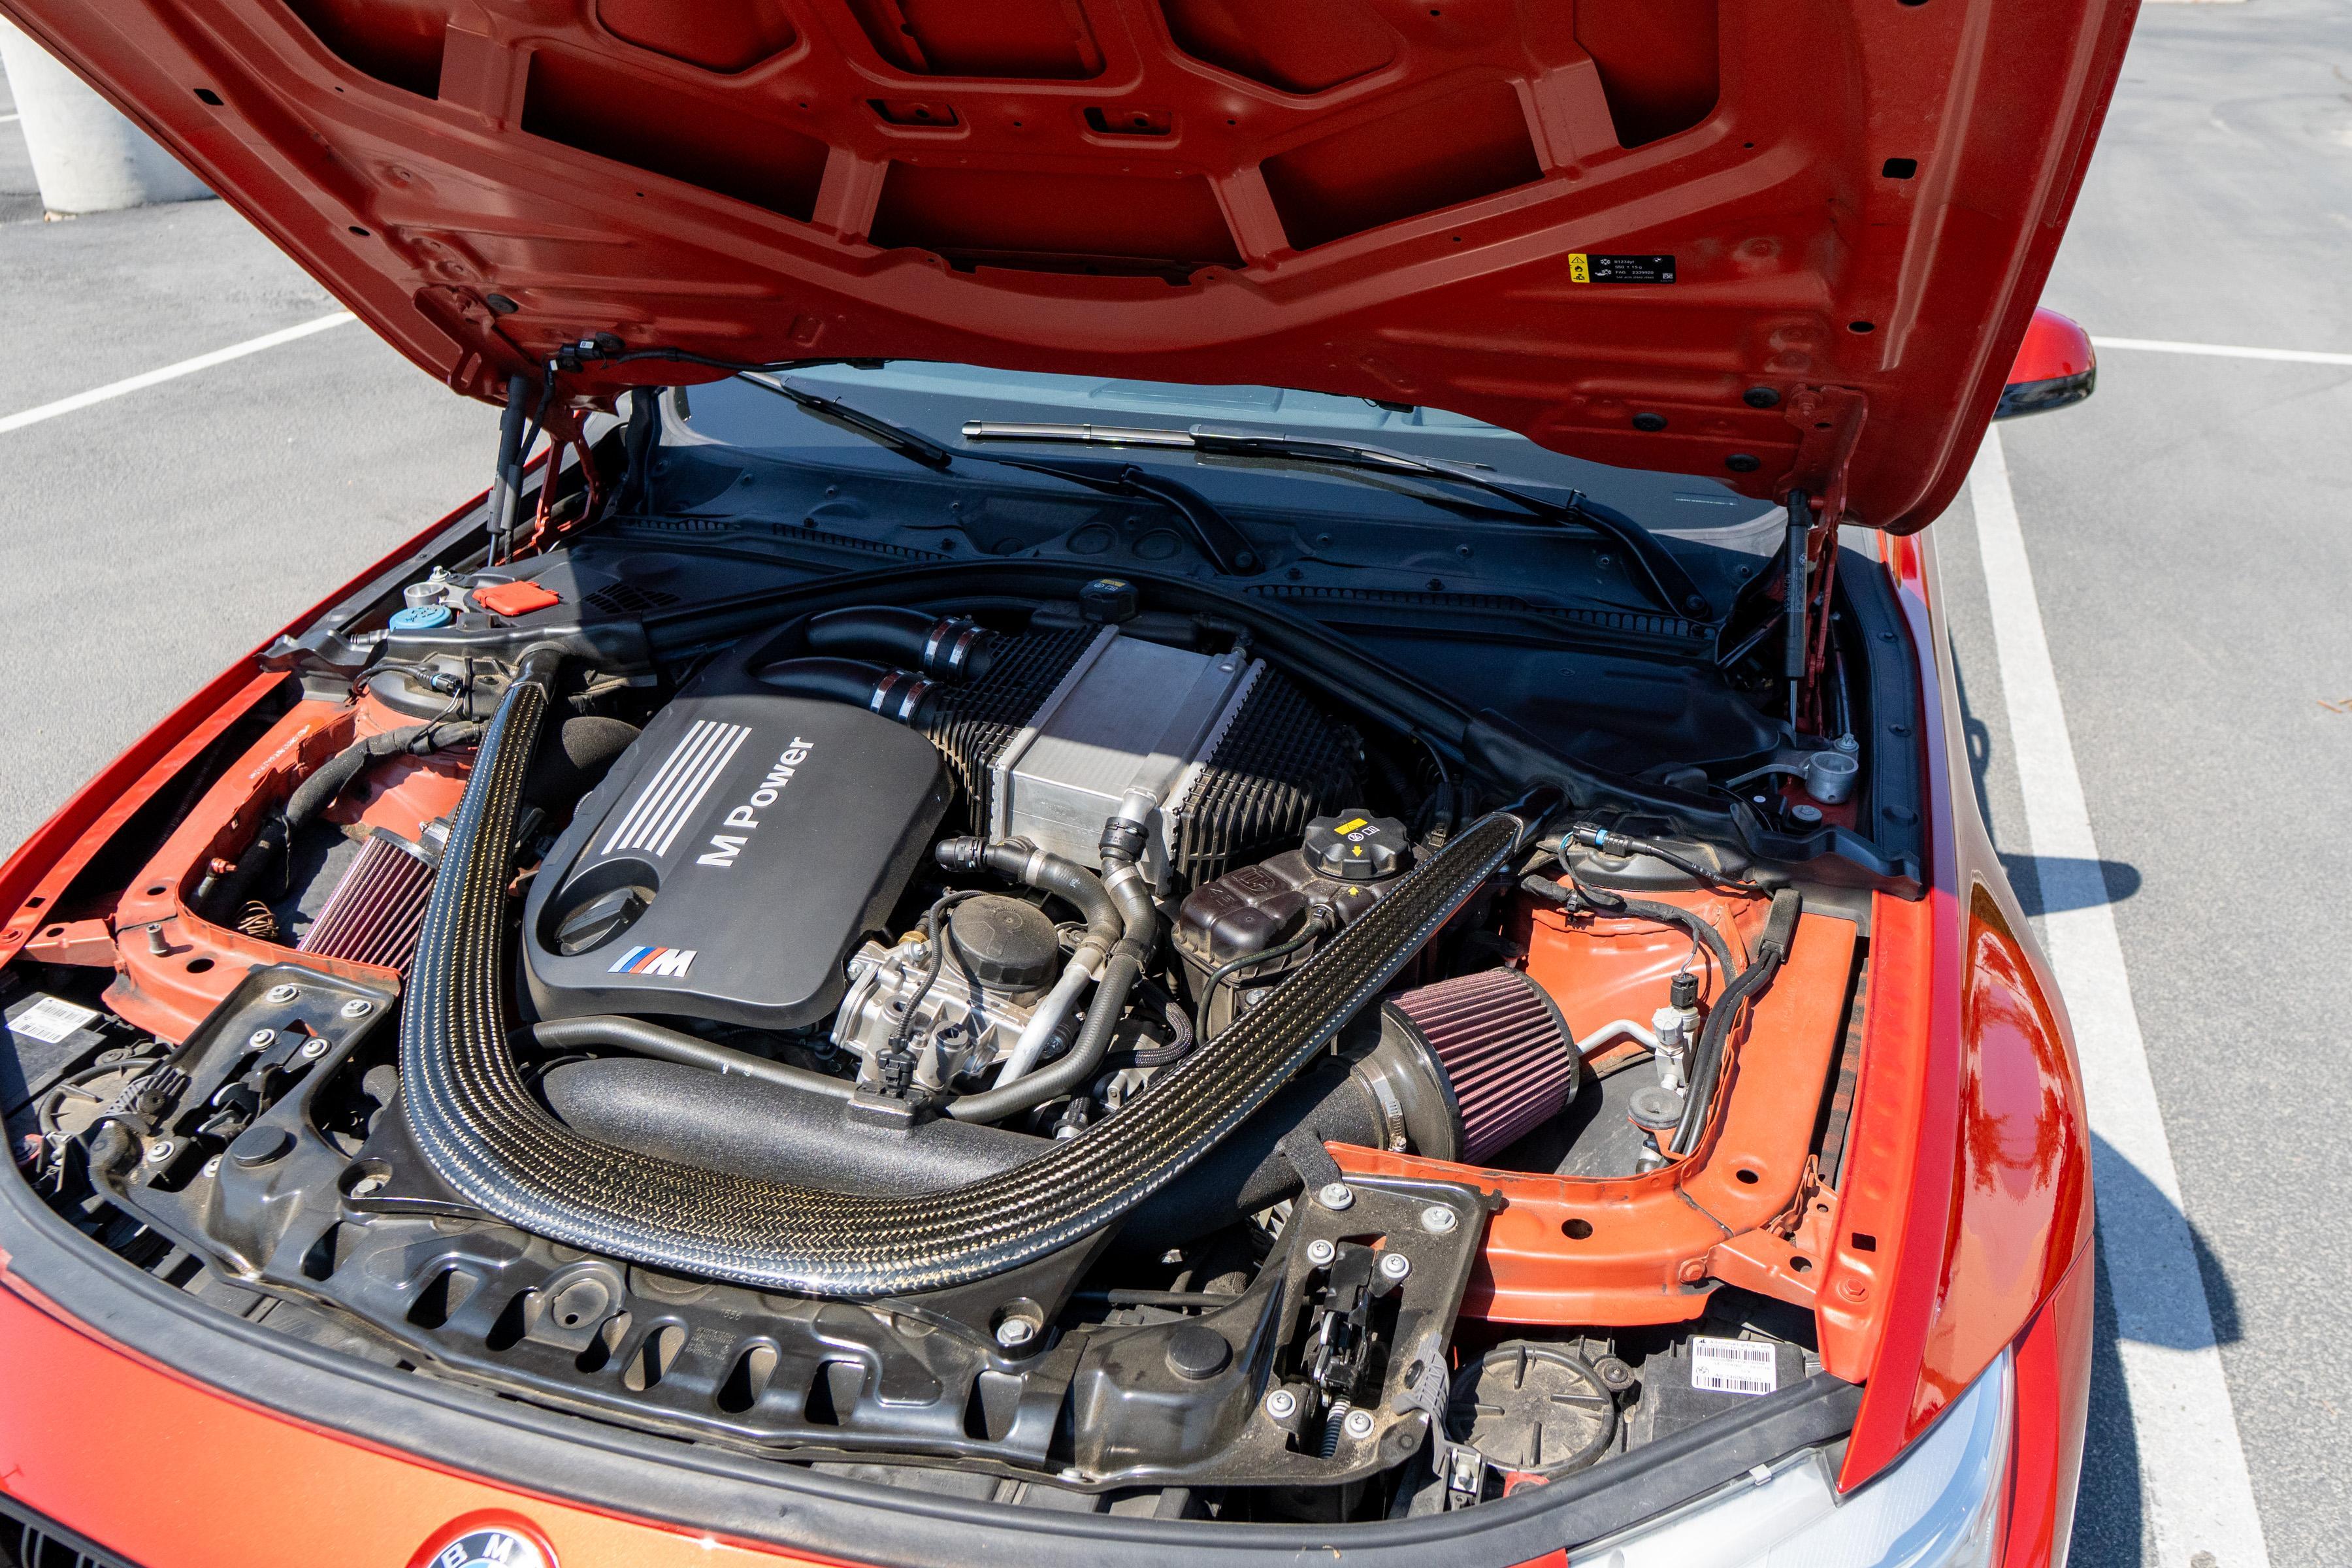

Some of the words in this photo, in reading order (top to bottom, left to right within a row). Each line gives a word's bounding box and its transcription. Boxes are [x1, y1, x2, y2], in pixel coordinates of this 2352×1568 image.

[696, 834, 748, 867] M
[723, 736, 815, 828] Power
[441, 1533, 541, 1568] BM
